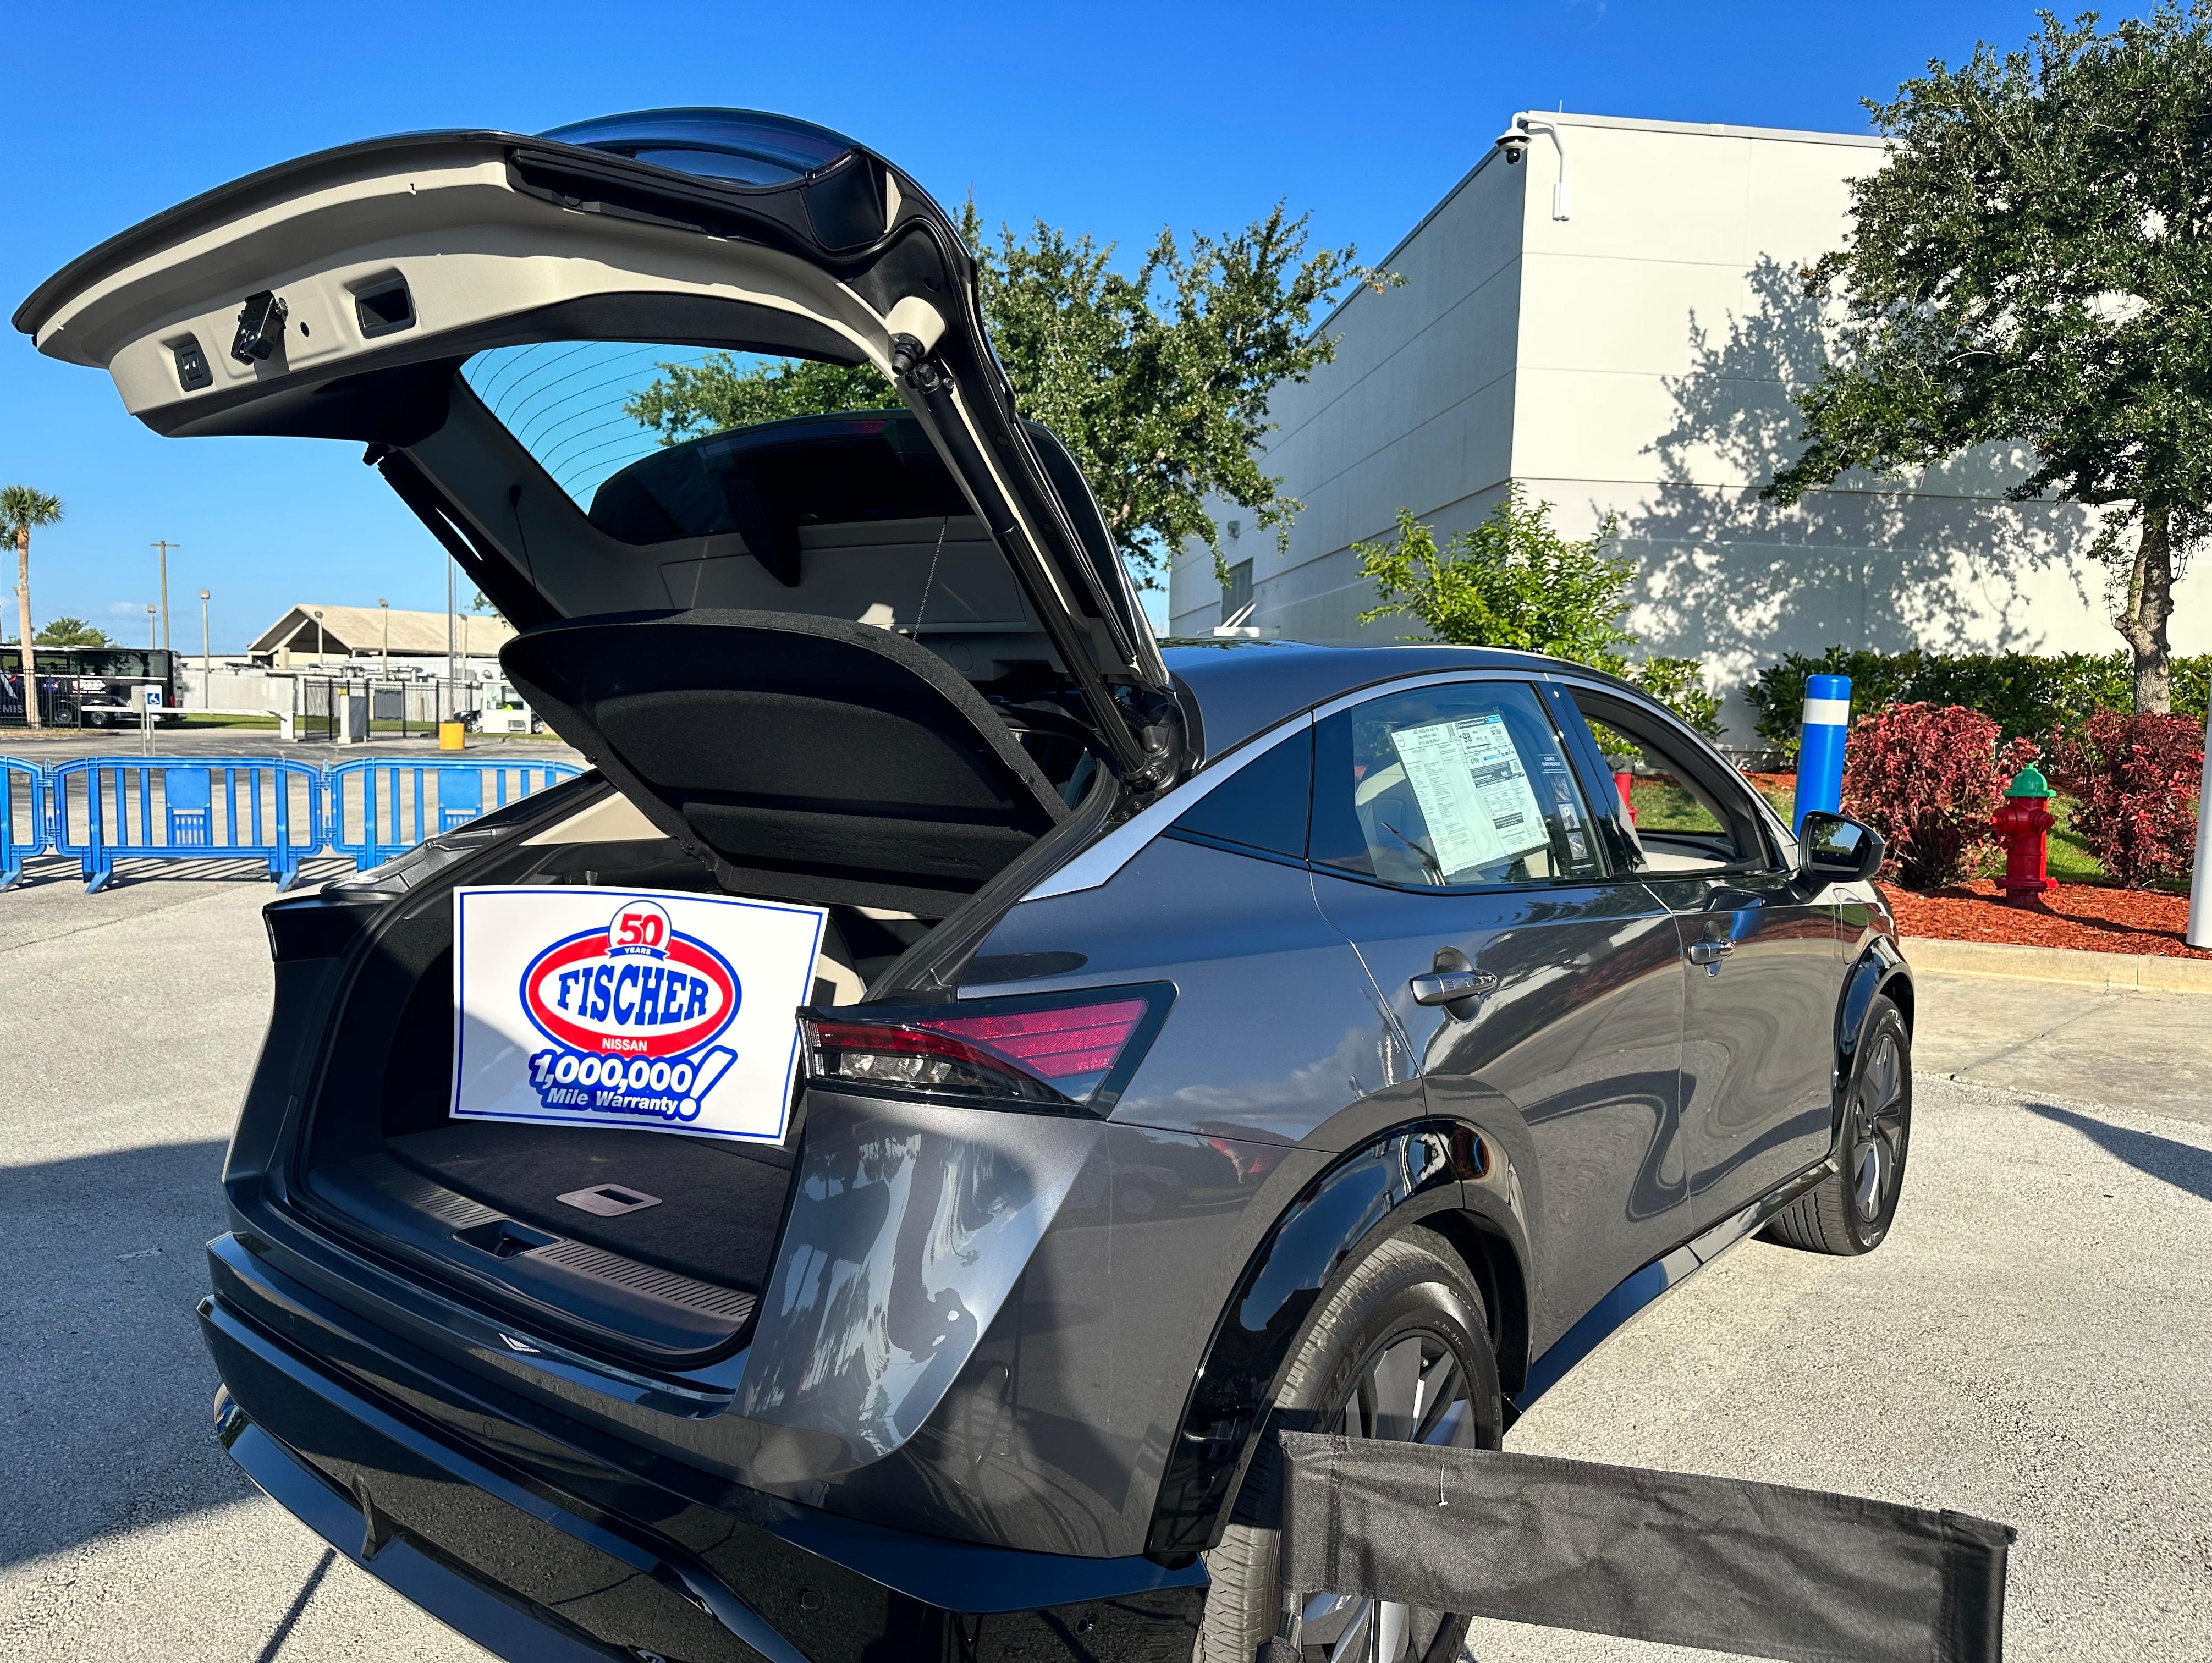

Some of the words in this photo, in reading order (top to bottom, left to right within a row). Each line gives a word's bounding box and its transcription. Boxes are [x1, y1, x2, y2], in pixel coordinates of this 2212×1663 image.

[0, 704, 24, 713] MIS
[1462, 732, 1472, 743] 98
[617, 913, 664, 948] 50
[624, 947, 651, 955] YEARS
[557, 963, 709, 1026] FISCHER
[602, 1038, 648, 1052] NISSAN
[547, 1088, 589, 1105] Mile
